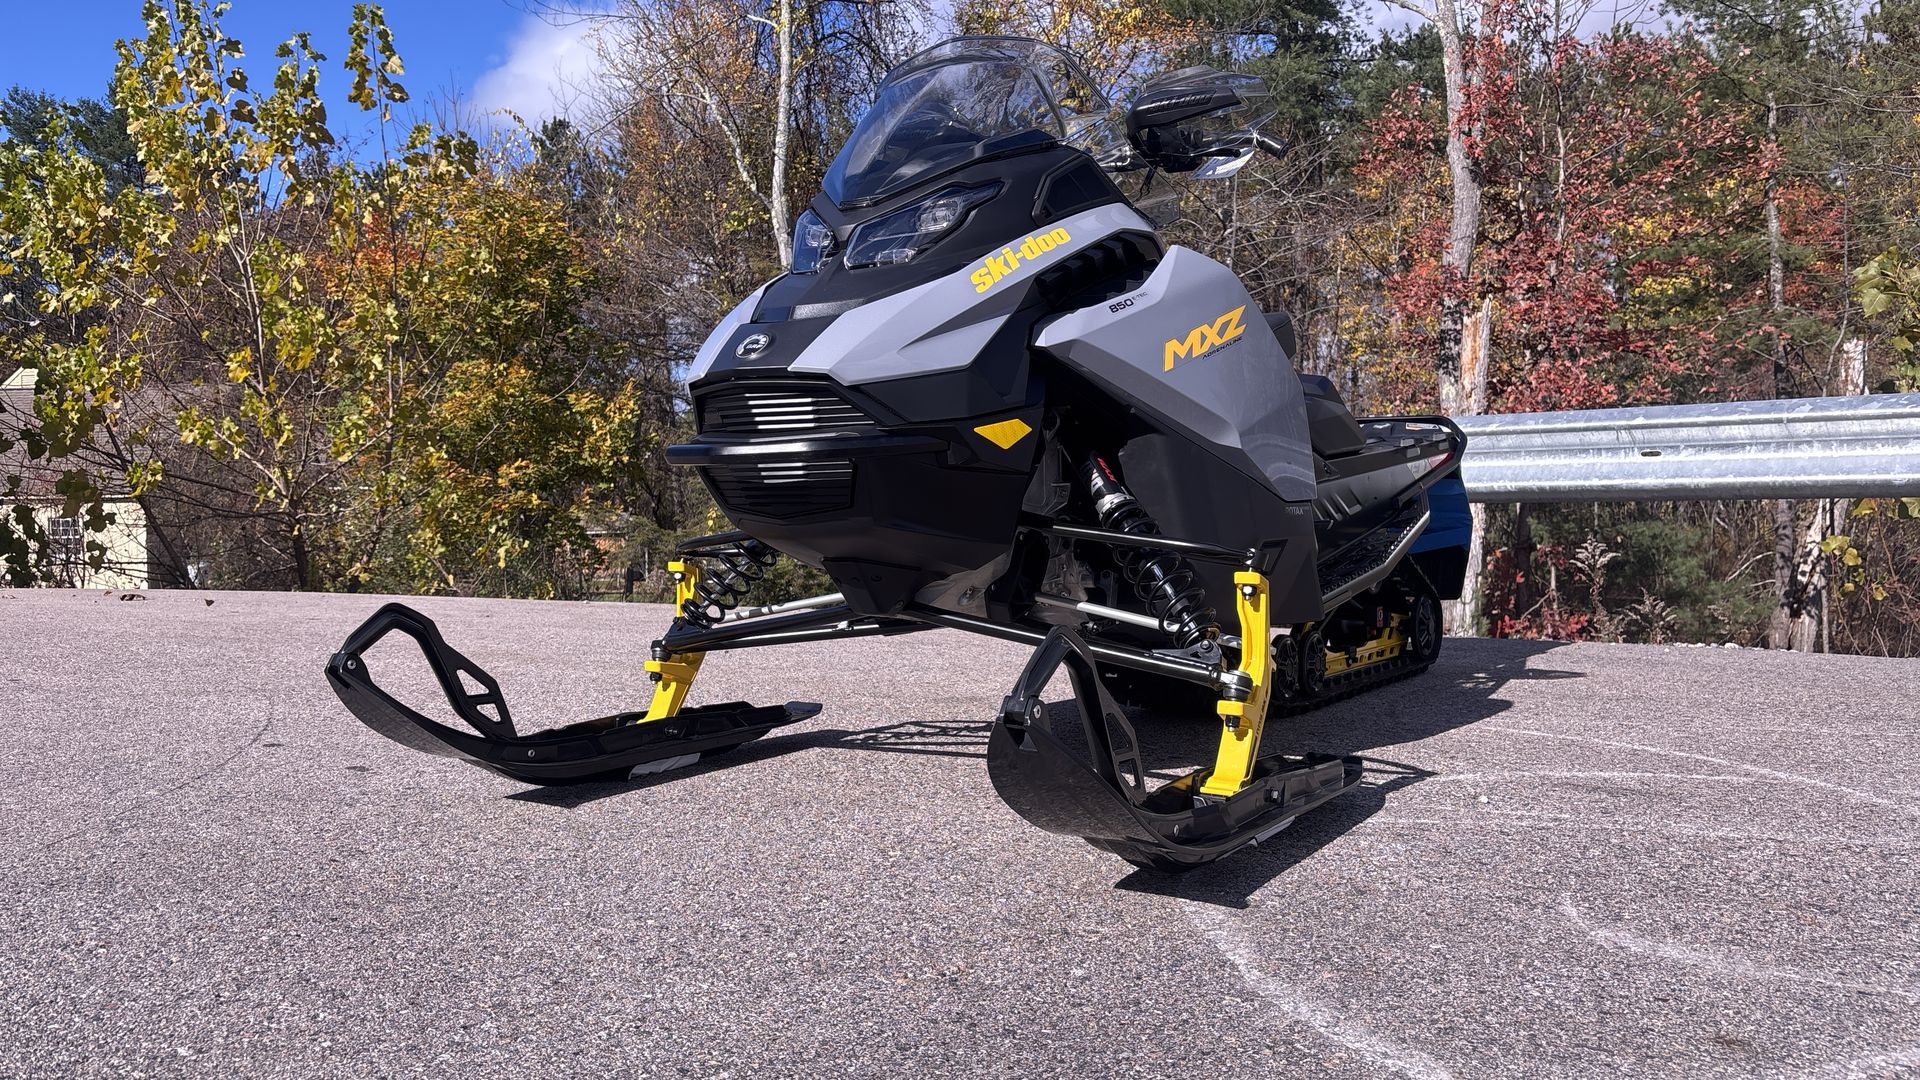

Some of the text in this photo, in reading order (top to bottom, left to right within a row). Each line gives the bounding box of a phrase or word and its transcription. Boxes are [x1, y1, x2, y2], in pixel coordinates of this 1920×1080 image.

[970, 227, 1072, 293] ski-doo
[1109, 298, 1134, 313] 850
[1164, 304, 1248, 372] MXZ
